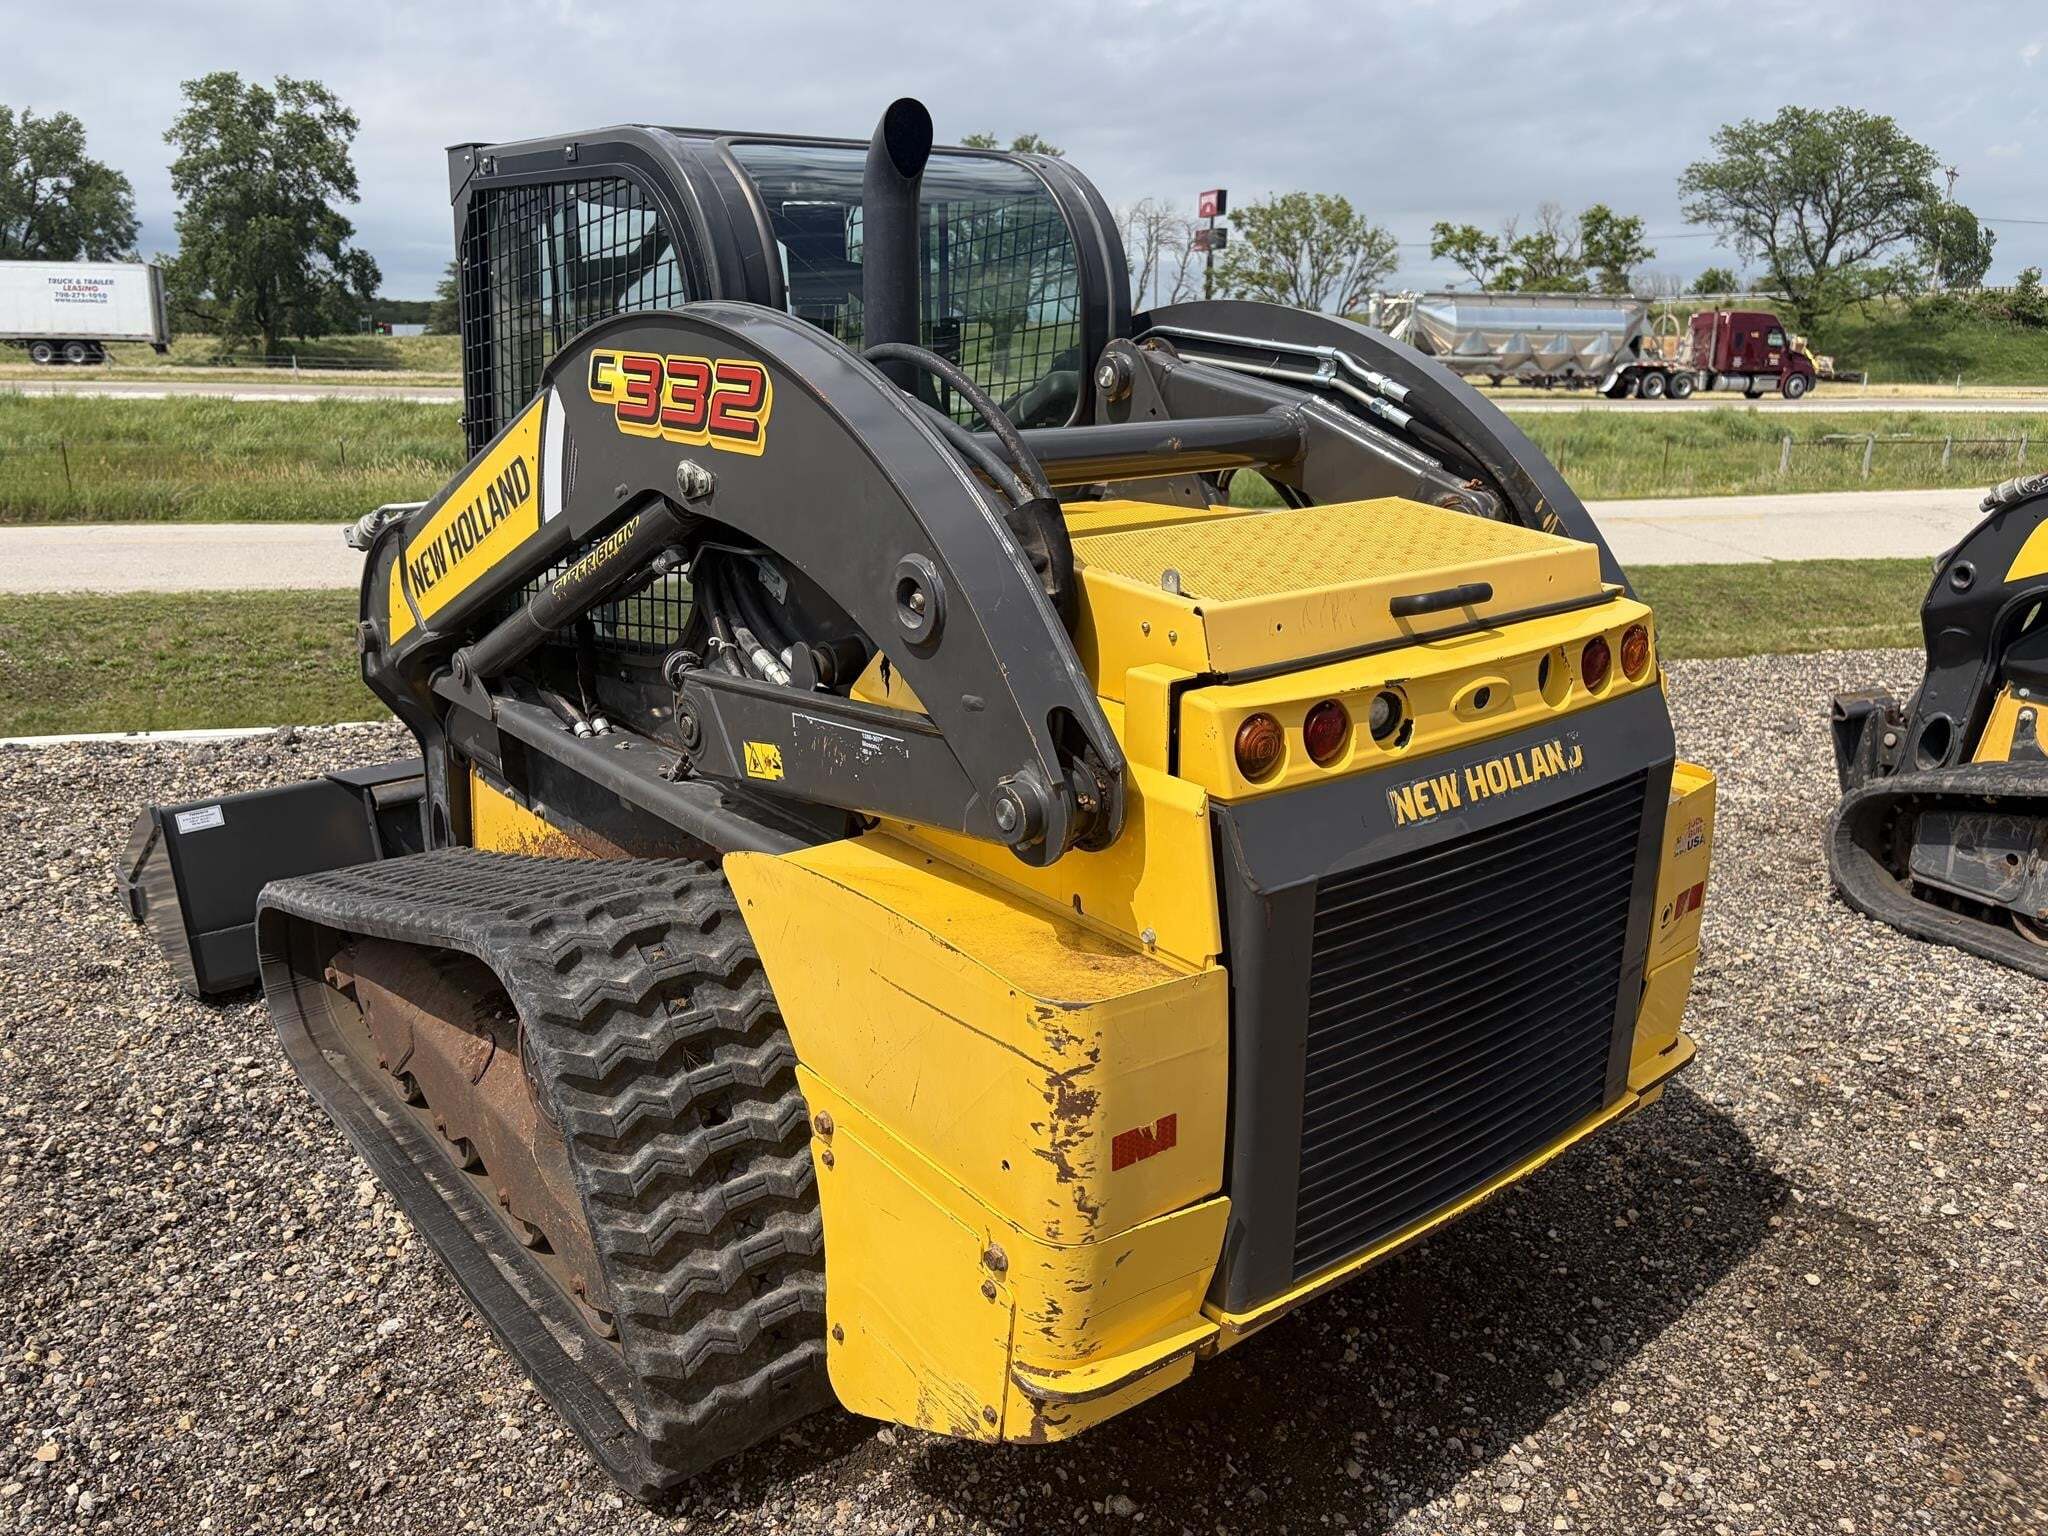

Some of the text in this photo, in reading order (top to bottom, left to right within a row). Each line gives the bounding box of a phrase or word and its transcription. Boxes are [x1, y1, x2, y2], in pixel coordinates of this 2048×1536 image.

[48, 277, 73, 285] TRUCK
[589, 350, 772, 454] C332
[409, 455, 531, 599] NEW HOLLAND
[1388, 770, 1462, 825] NEW
[1687, 834, 1706, 851] USA
